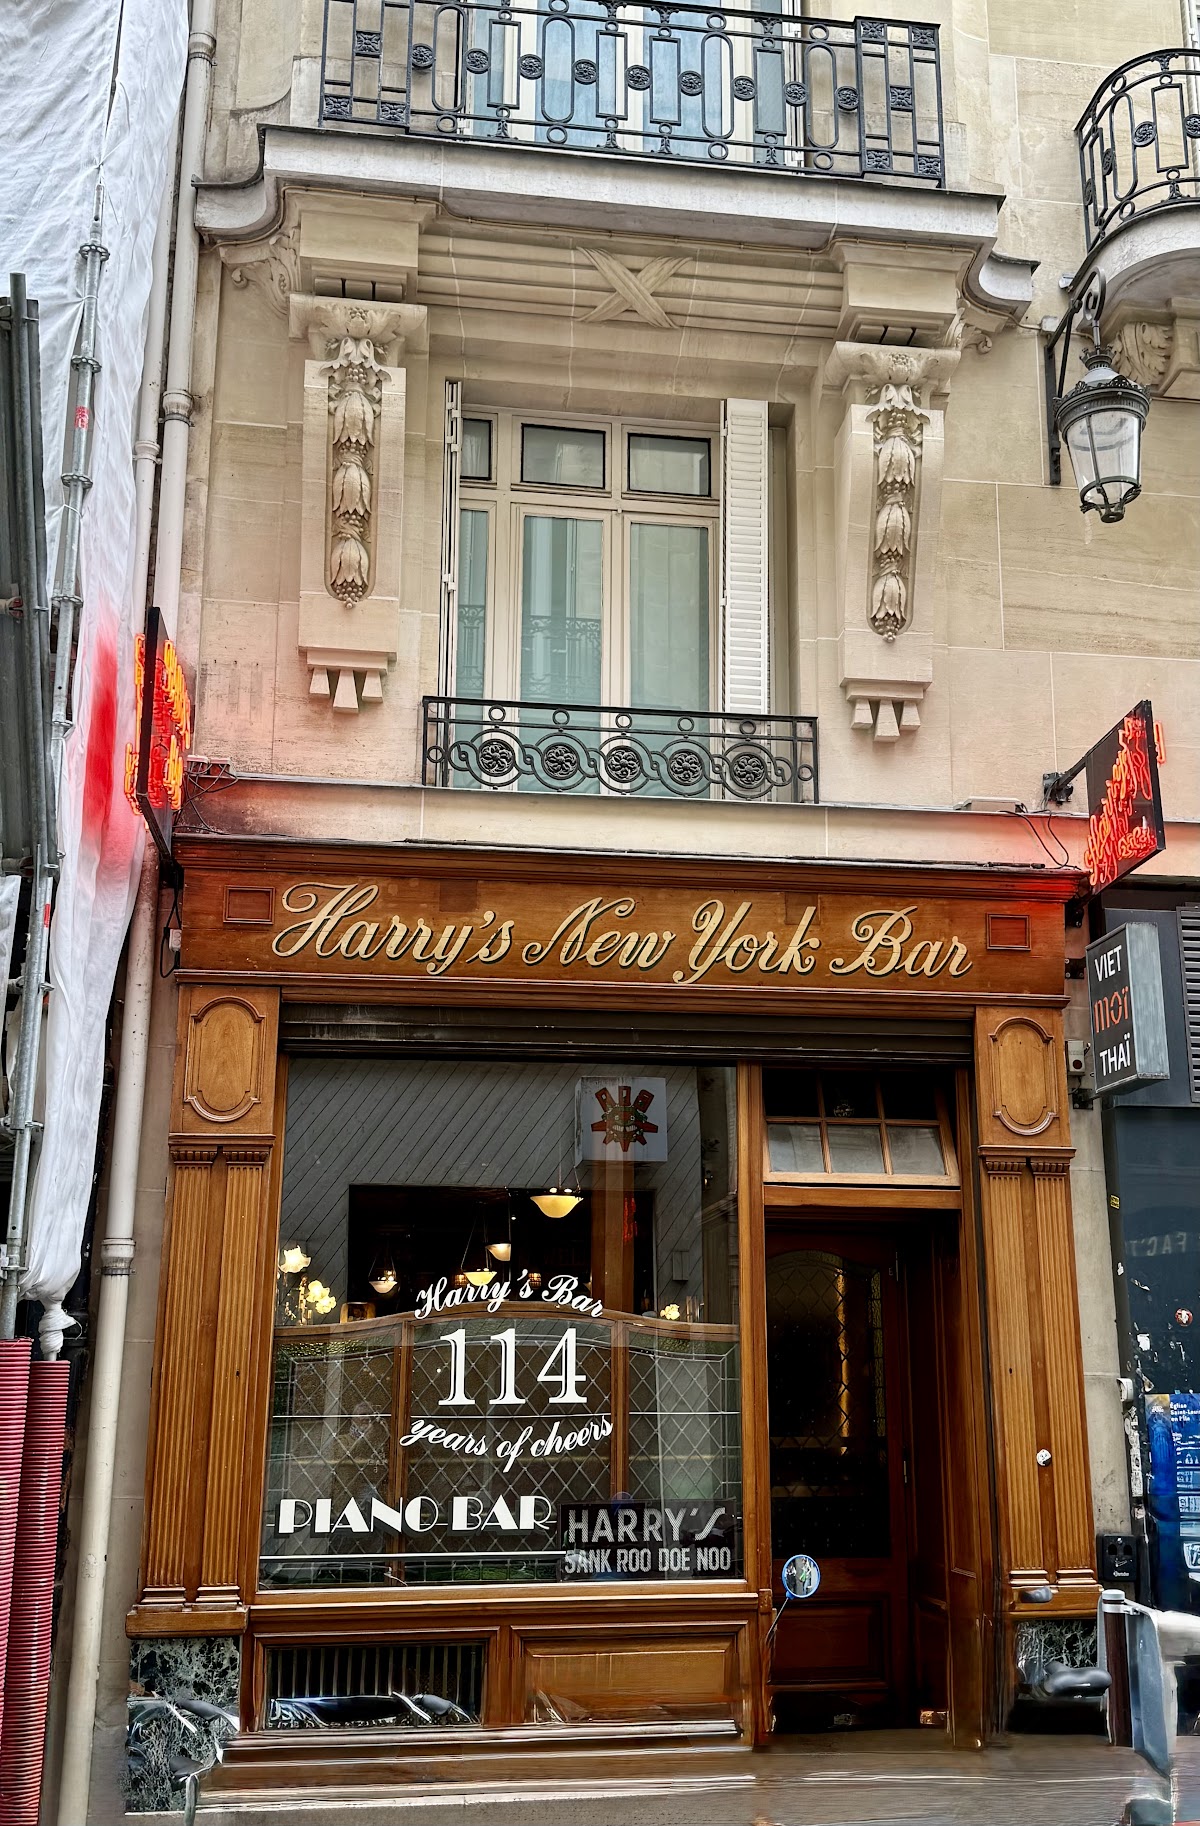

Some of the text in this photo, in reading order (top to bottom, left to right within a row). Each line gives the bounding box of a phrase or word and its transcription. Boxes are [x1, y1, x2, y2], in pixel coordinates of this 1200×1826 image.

[272, 882, 973, 984] Harry's New York Bar
[1094, 945, 1122, 982] VIET
[1100, 1032, 1131, 1077] THAÏ
[414, 1269, 604, 1319] Harry's Bar
[438, 1328, 588, 1406] 114
[400, 1415, 613, 1473] years of cheers
[278, 1495, 553, 1534] PIANO BAR
[568, 1507, 726, 1543] HARRY'S
[564, 1546, 732, 1574] SANK ROO DOE NOO
